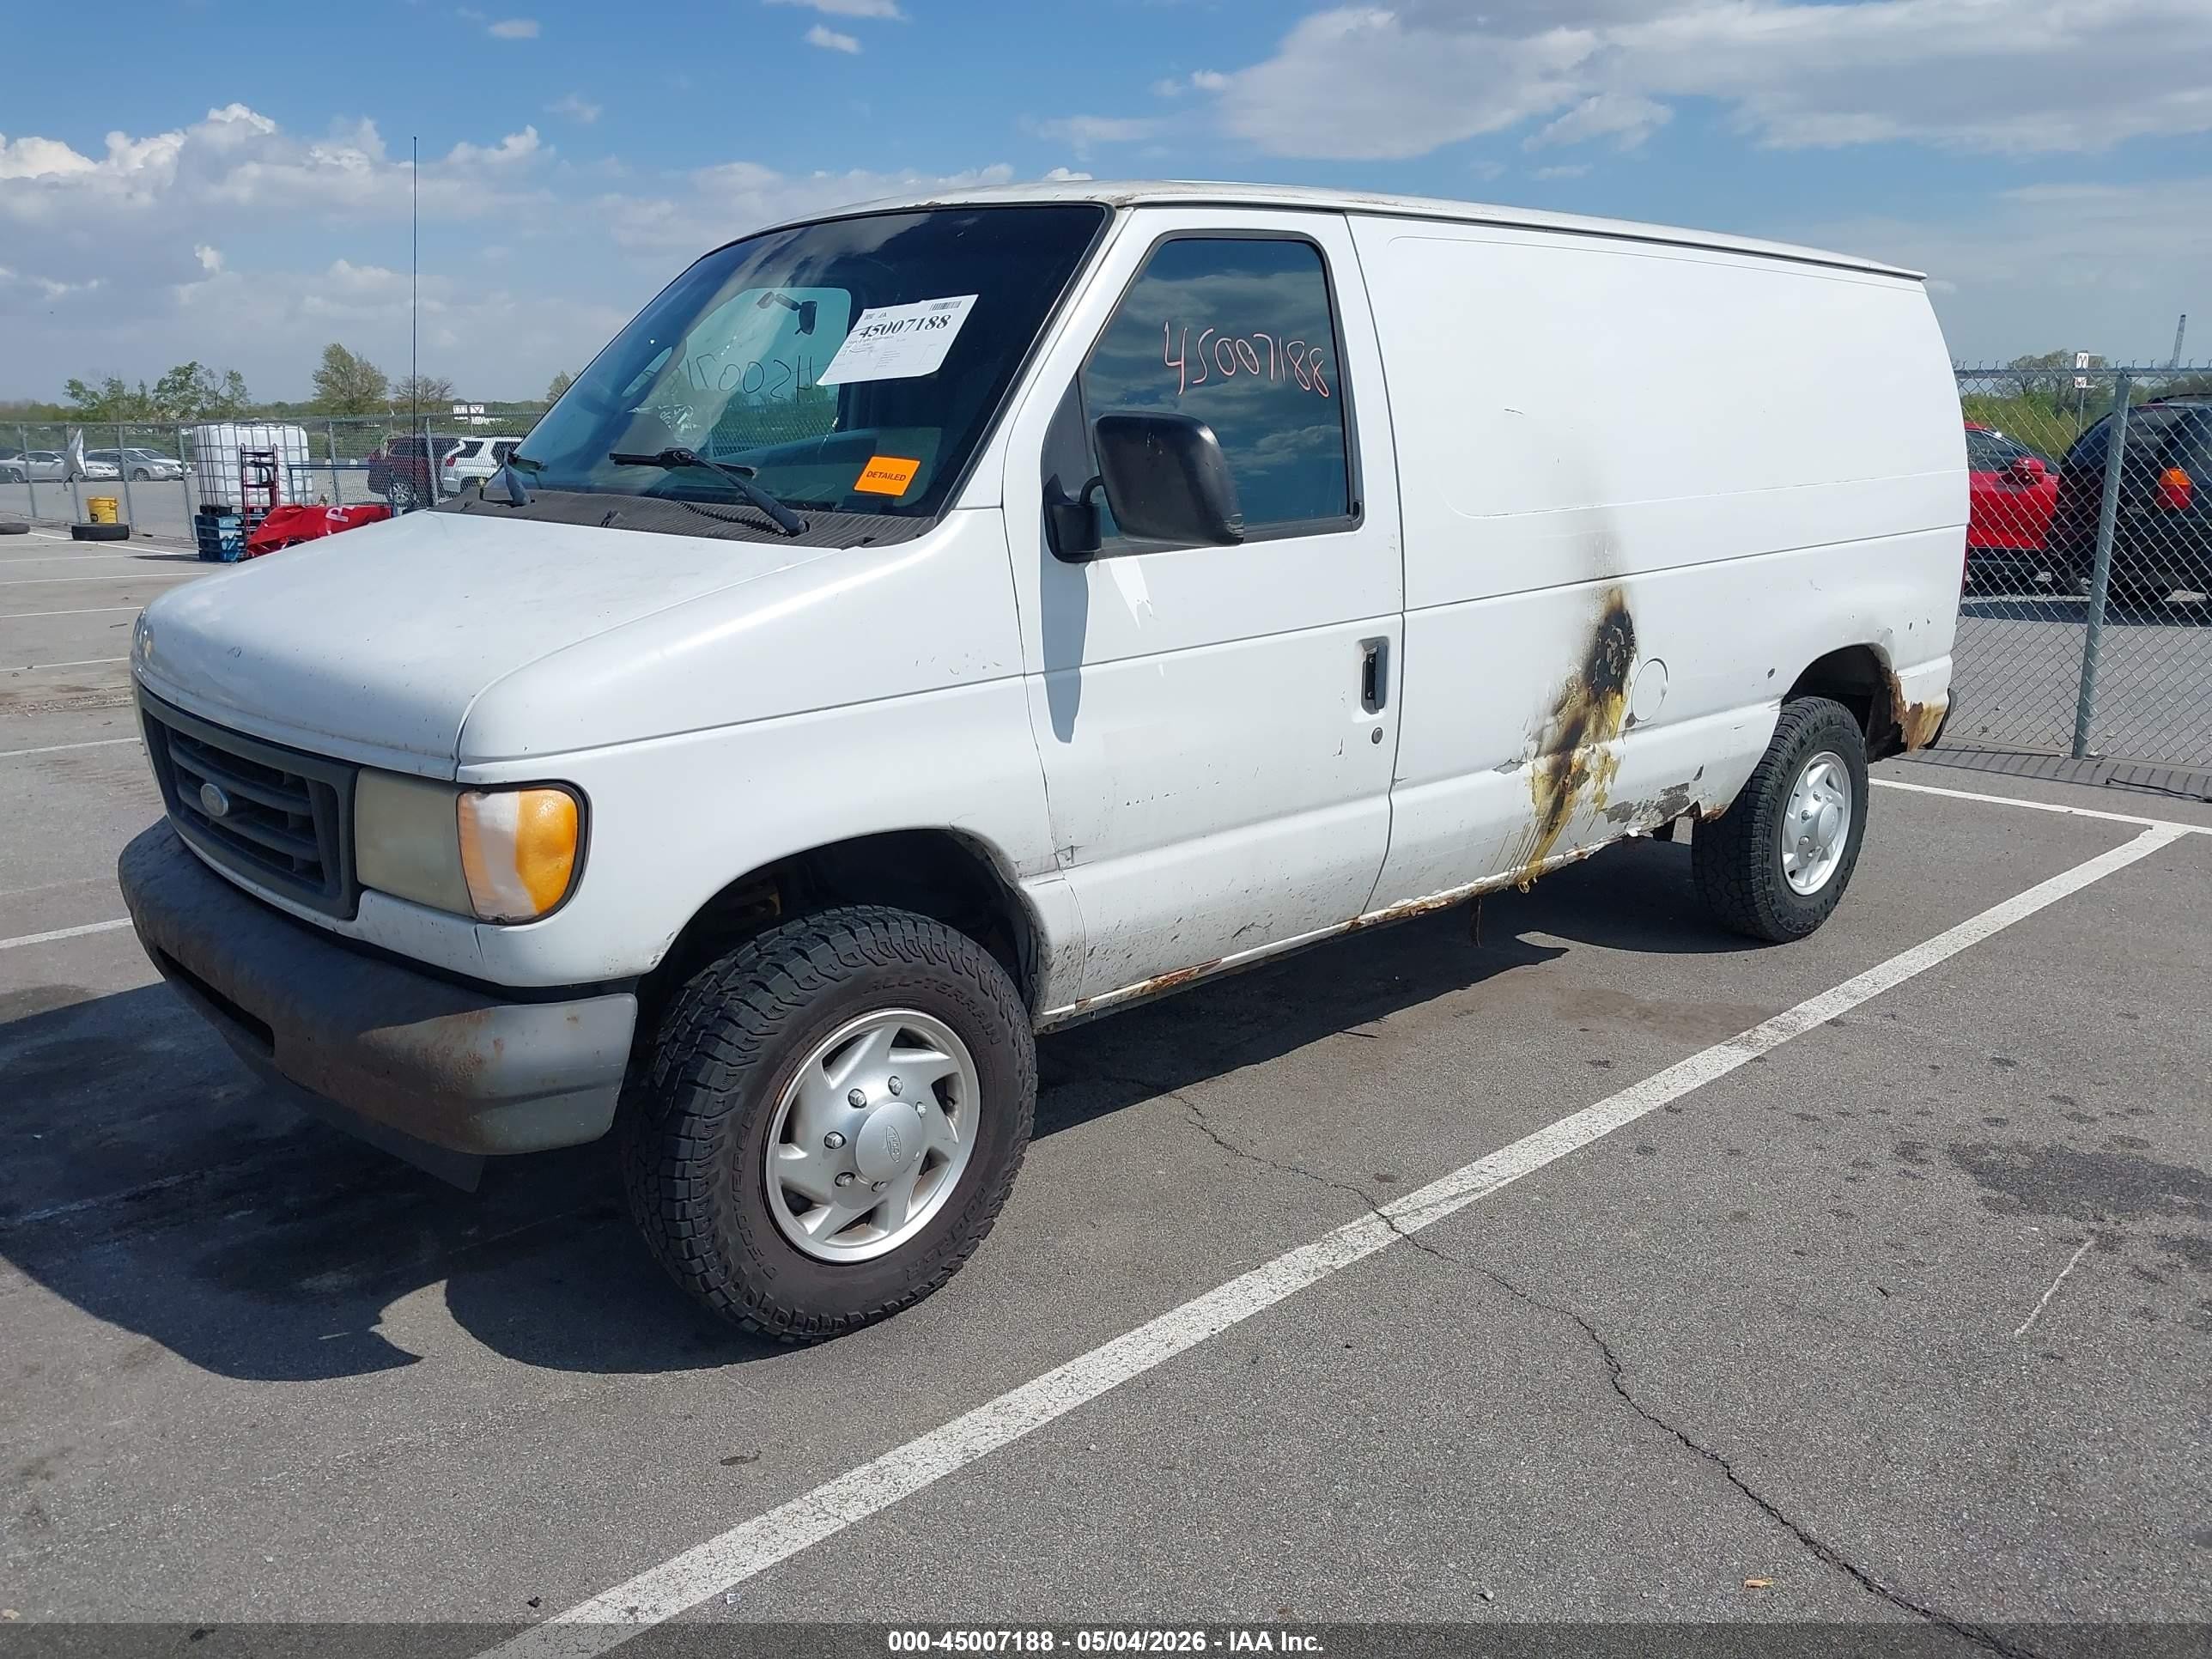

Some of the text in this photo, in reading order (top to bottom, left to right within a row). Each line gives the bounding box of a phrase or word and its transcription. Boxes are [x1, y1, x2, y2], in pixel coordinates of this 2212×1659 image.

[859, 314, 951, 338] 45007188
[1164, 321, 1330, 398] 45007188
[866, 470, 907, 482] DETAILED
